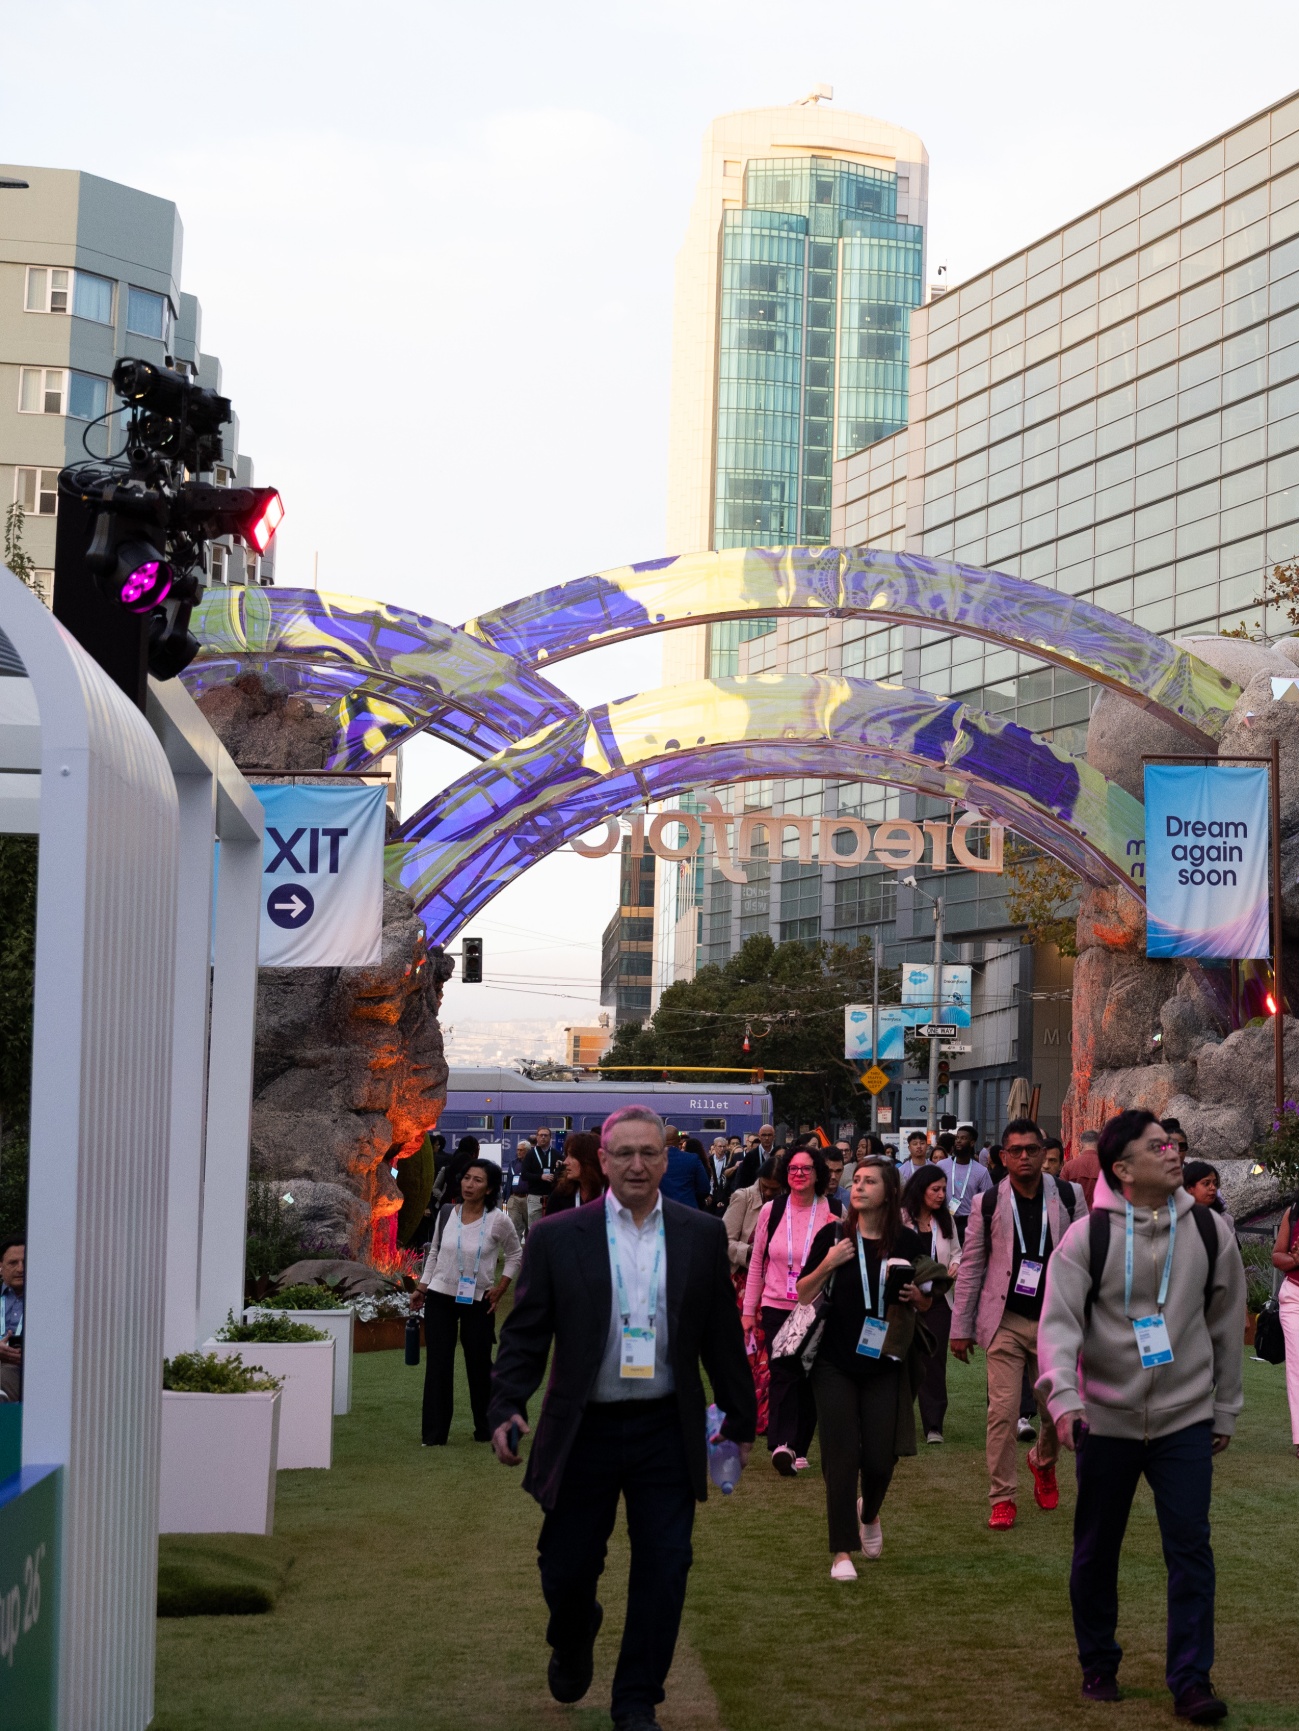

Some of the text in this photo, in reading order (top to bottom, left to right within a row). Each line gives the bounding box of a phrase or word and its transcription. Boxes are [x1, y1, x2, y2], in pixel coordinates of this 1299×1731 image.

[1166, 815, 1248, 839] Dream
[264, 827, 348, 873] XIT
[1171, 841, 1243, 867] again
[1178, 868, 1237, 886] soon
[690, 1099, 729, 1109] Rillet
